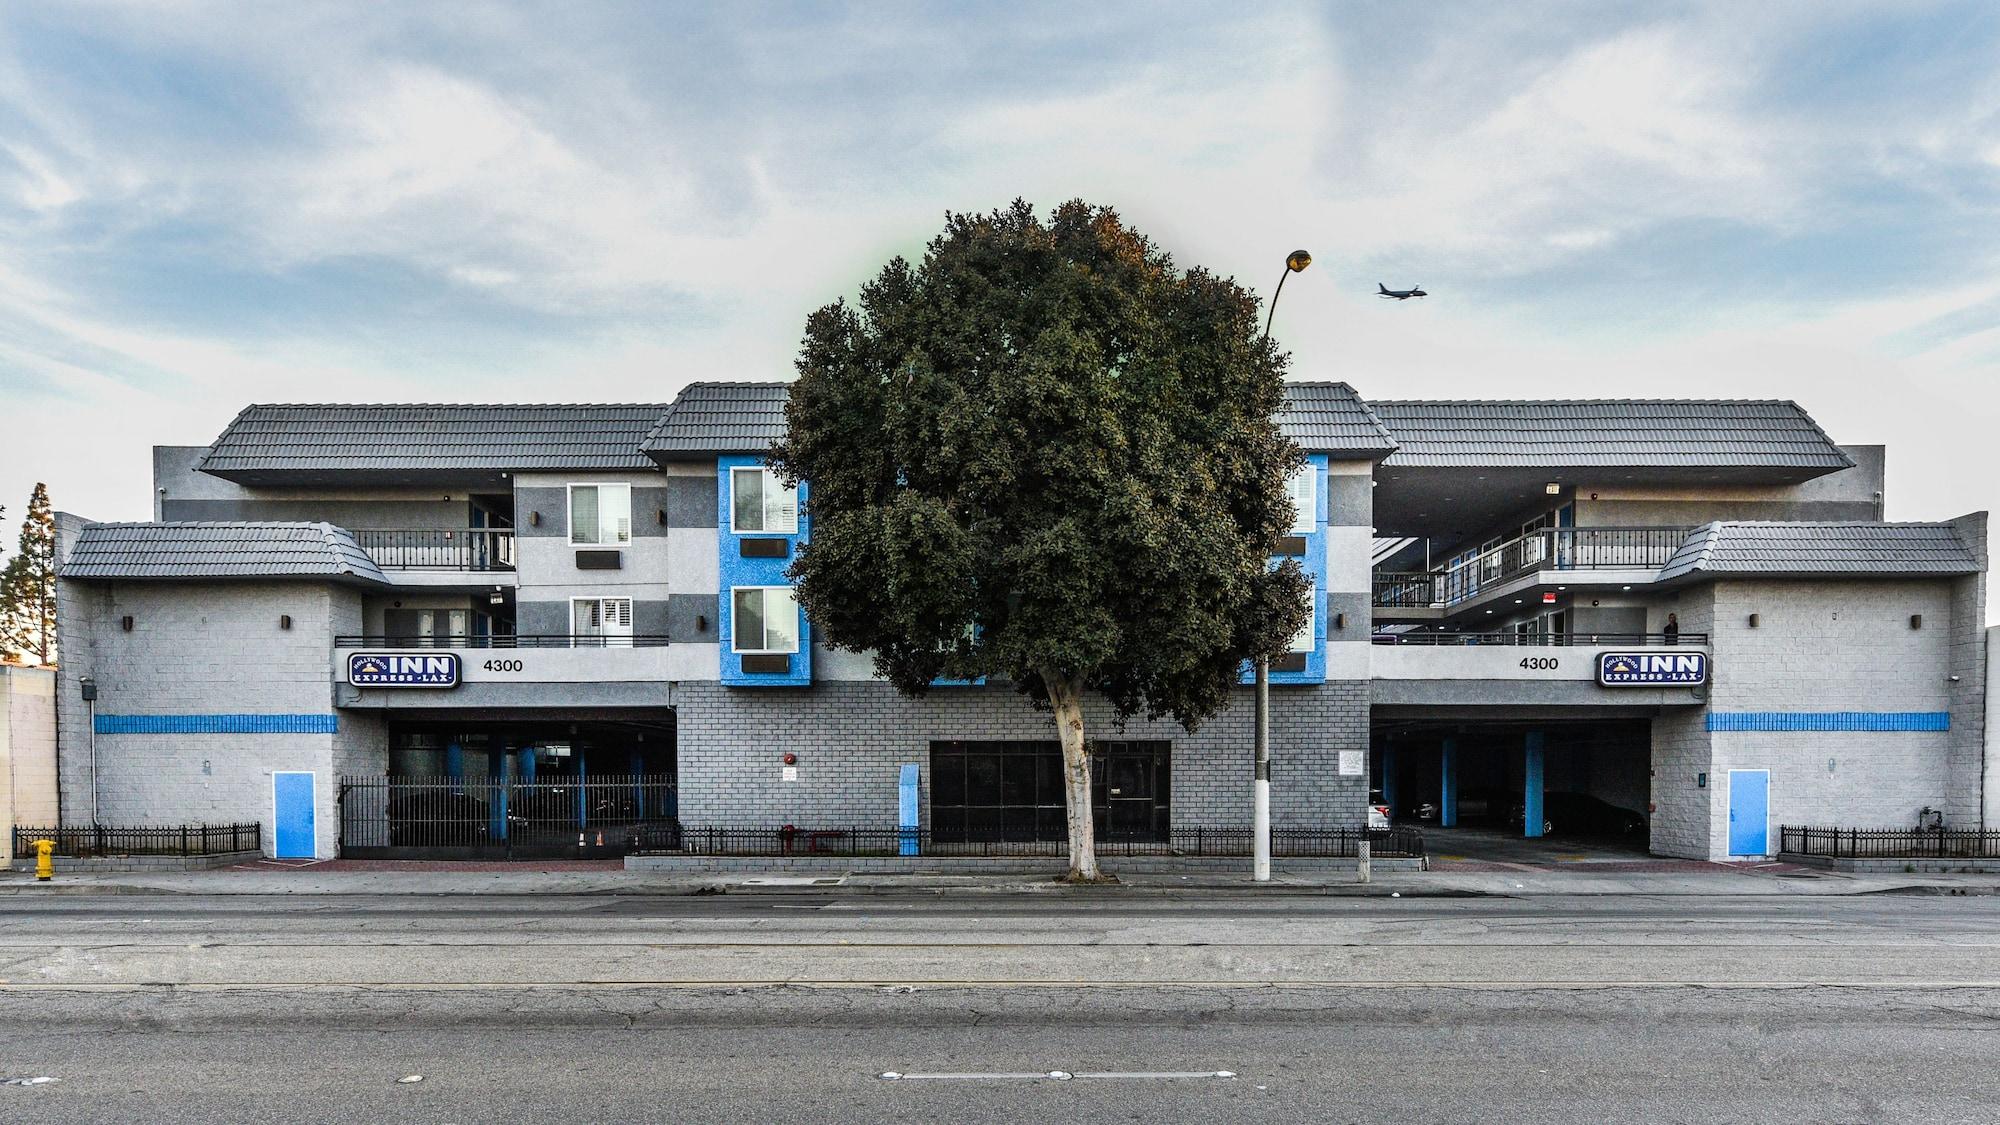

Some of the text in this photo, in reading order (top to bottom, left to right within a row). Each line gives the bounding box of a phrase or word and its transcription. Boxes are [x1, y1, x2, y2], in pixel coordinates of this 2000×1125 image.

[354, 657, 387, 670] HOLLYWOOD
[389, 657, 449, 673] INN
[483, 660, 523, 672] 4300
[1519, 658, 1558, 670] 4300
[1605, 657, 1638, 669] HOLLYWOOD
[1640, 656, 1699, 672] INN
[354, 674, 413, 682] EXPRESS
[1605, 673, 1663, 681] EXPRESS
